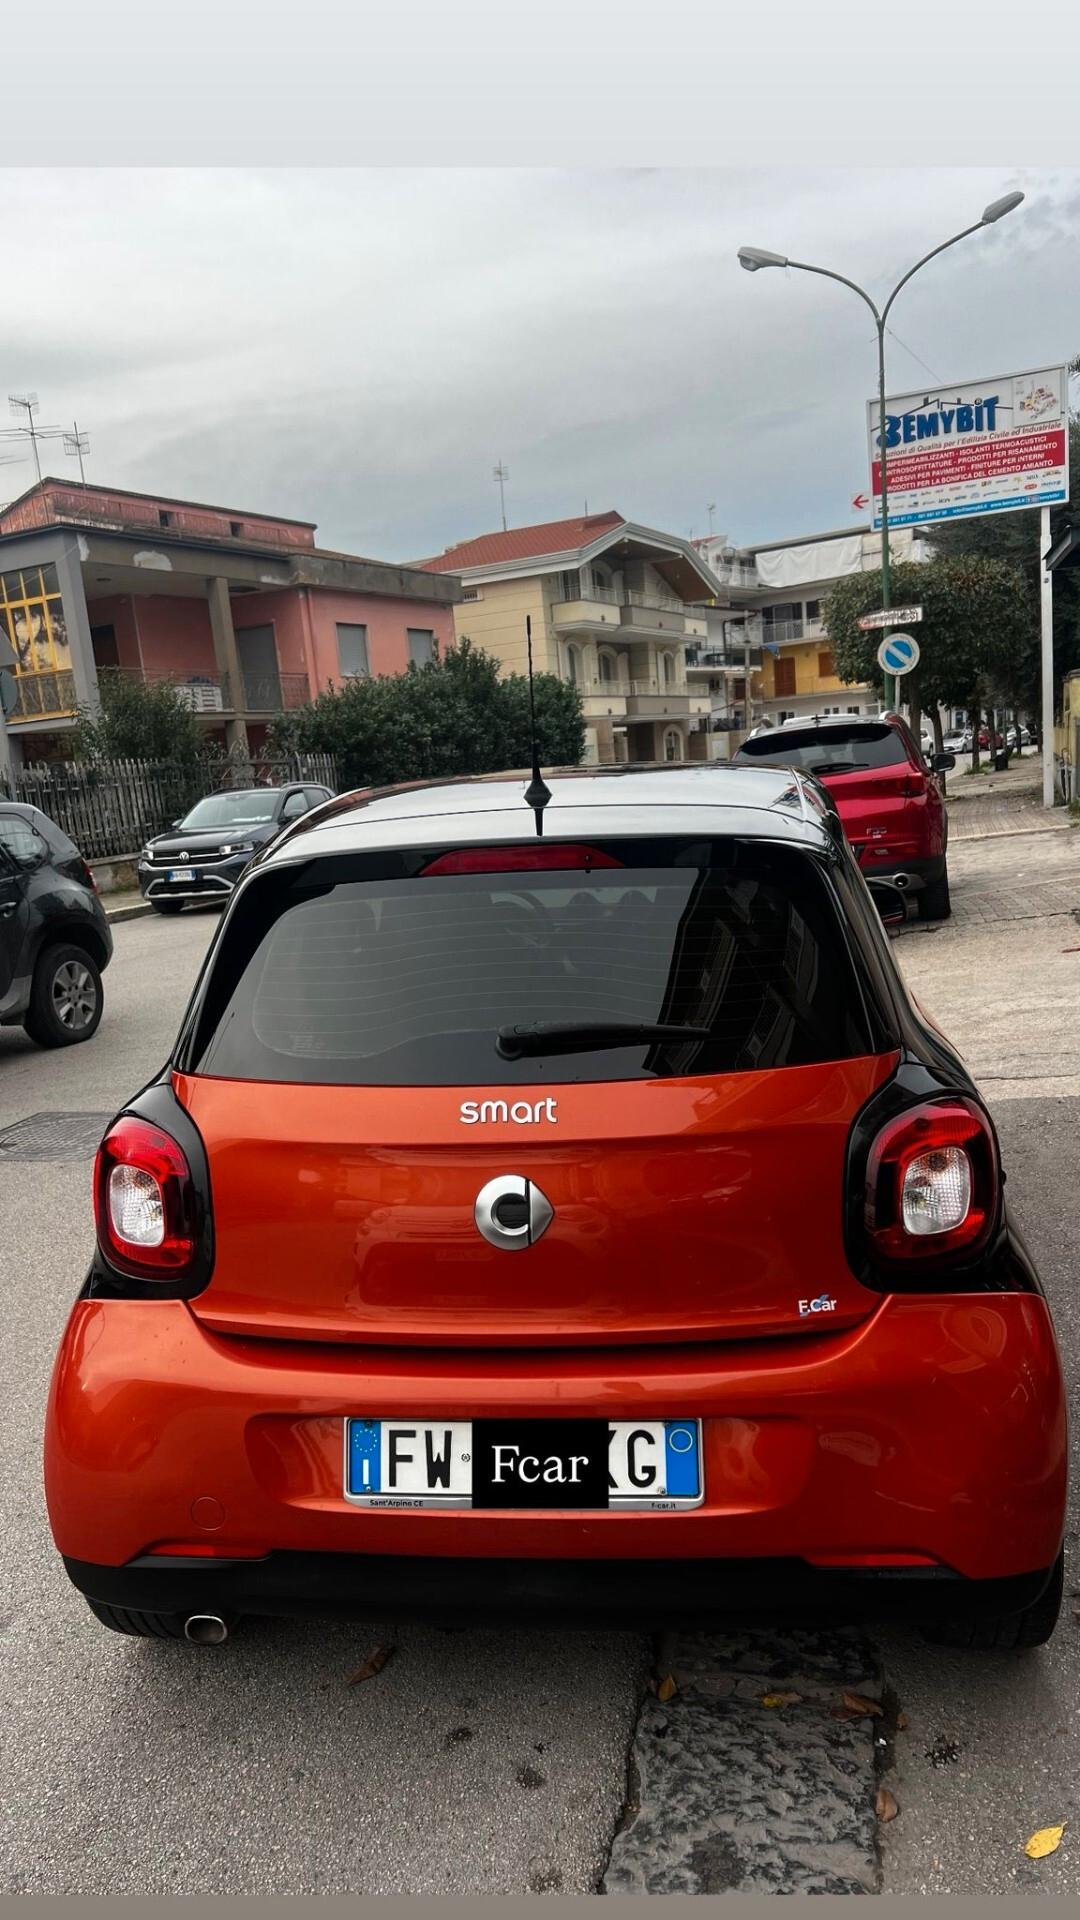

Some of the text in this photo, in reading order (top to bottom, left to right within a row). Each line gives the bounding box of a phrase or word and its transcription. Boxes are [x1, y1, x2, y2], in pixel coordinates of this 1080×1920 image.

[875, 449, 907, 460] Suzioni
[917, 441, 942, 453] Qualità
[944, 440, 955, 451] per
[989, 431, 1010, 440] Civile
[1011, 427, 1020, 436] ed
[1022, 422, 1062, 433] Industriale
[959, 445, 991, 456] ISOLANTI
[992, 436, 1047, 450] TERMOACUSTICI
[879, 442, 1058, 477] CNTROSOFFITTATURE PRODOTTI PER RISANAMENTO
[890, 453, 1045, 483] ADESIVI PER PAVIMENTI FINITURE PER INTERNI
[886, 481, 916, 492] RODOTTI
[917, 479, 930, 488] PER
[931, 477, 941, 485] LA
[942, 472, 973, 484] BONIFICA
[973, 470, 987, 479] DEL
[988, 464, 1021, 476] CEMENTO
[1022, 459, 1054, 471] AMIANTO
[459, 1097, 558, 1124] smart
[798, 1299, 838, 1314] F.Car
[369, 1499, 412, 1508] Sant'Arpino
